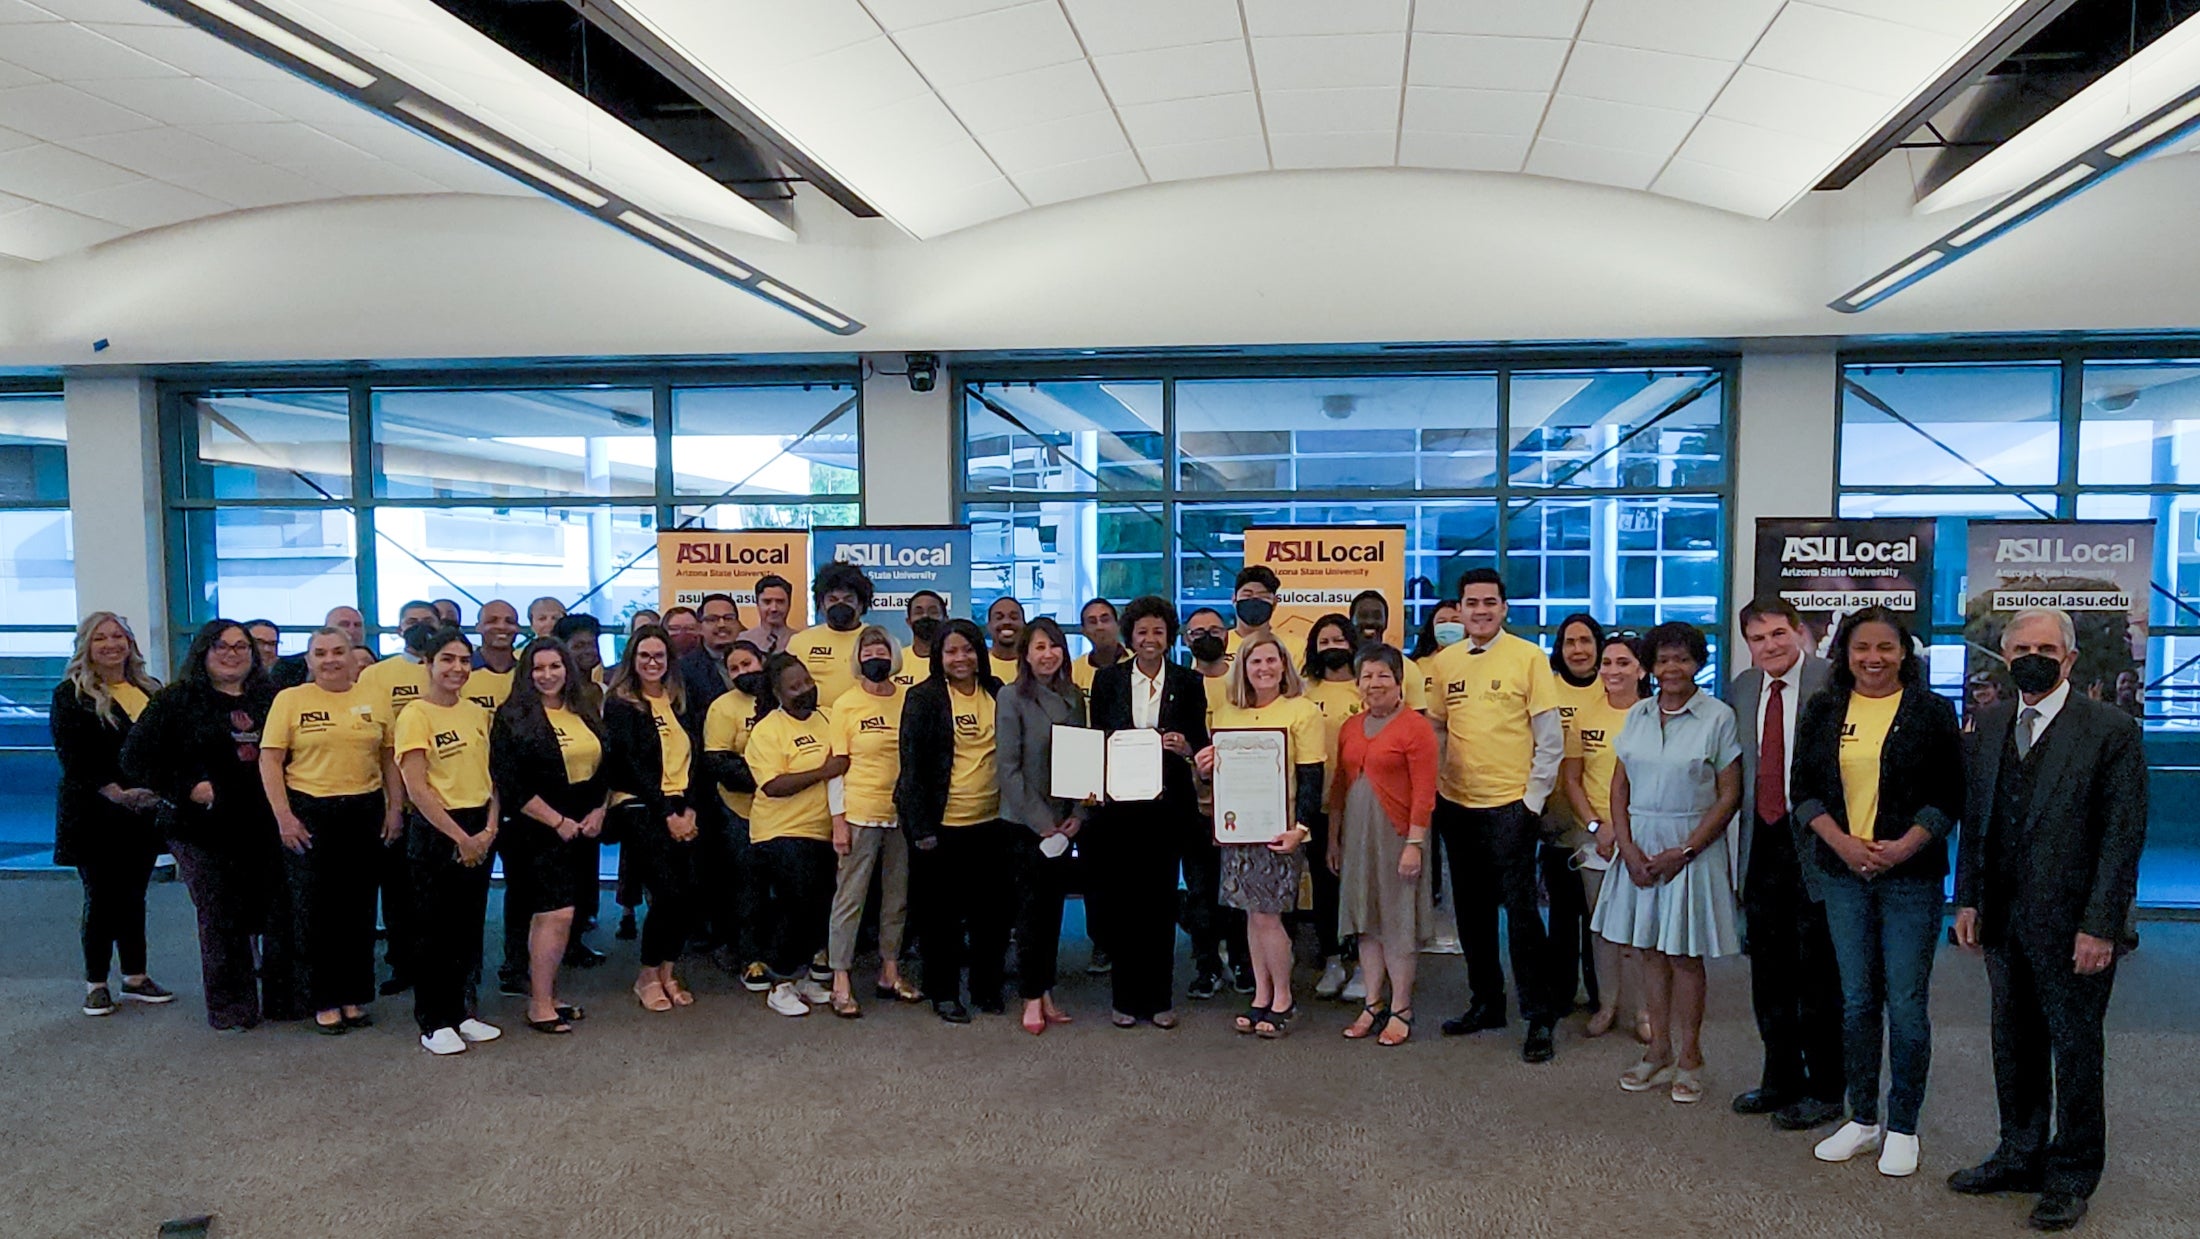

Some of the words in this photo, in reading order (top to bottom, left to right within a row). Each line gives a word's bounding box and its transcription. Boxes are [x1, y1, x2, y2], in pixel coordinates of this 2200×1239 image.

[676, 543, 721, 563] ASU
[726, 543, 789, 564] Local
[834, 543, 881, 566] ASU
[884, 543, 952, 566] Local
[1265, 541, 1312, 562] ASU
[1317, 540, 1384, 562] Local
[1781, 537, 1836, 562] ASU
[1839, 536, 1917, 562] Local
[1995, 538, 2051, 562] ASU
[2055, 538, 2135, 562] Local
[676, 569, 708, 577] Arizona
[709, 569, 732, 577] State
[868, 571, 892, 580] State
[892, 571, 937, 581] University
[1275, 567, 1299, 576] izona
[1300, 567, 1324, 576] State
[1325, 567, 1369, 577] University
[1780, 567, 1820, 577] Arizona
[1821, 567, 1847, 577] State
[1848, 567, 1899, 578] University
[1996, 594, 2130, 607] asulocal.asu.edu
[809, 646, 832, 655] ASU
[392, 685, 419, 697] ASU
[300, 711, 330, 727] ASU
[860, 716, 885, 730] ASU
[955, 713, 978, 725] ASU
[435, 730, 460, 747] ASU
[794, 734, 817, 747] ASU
[1581, 730, 1605, 741] ASU
